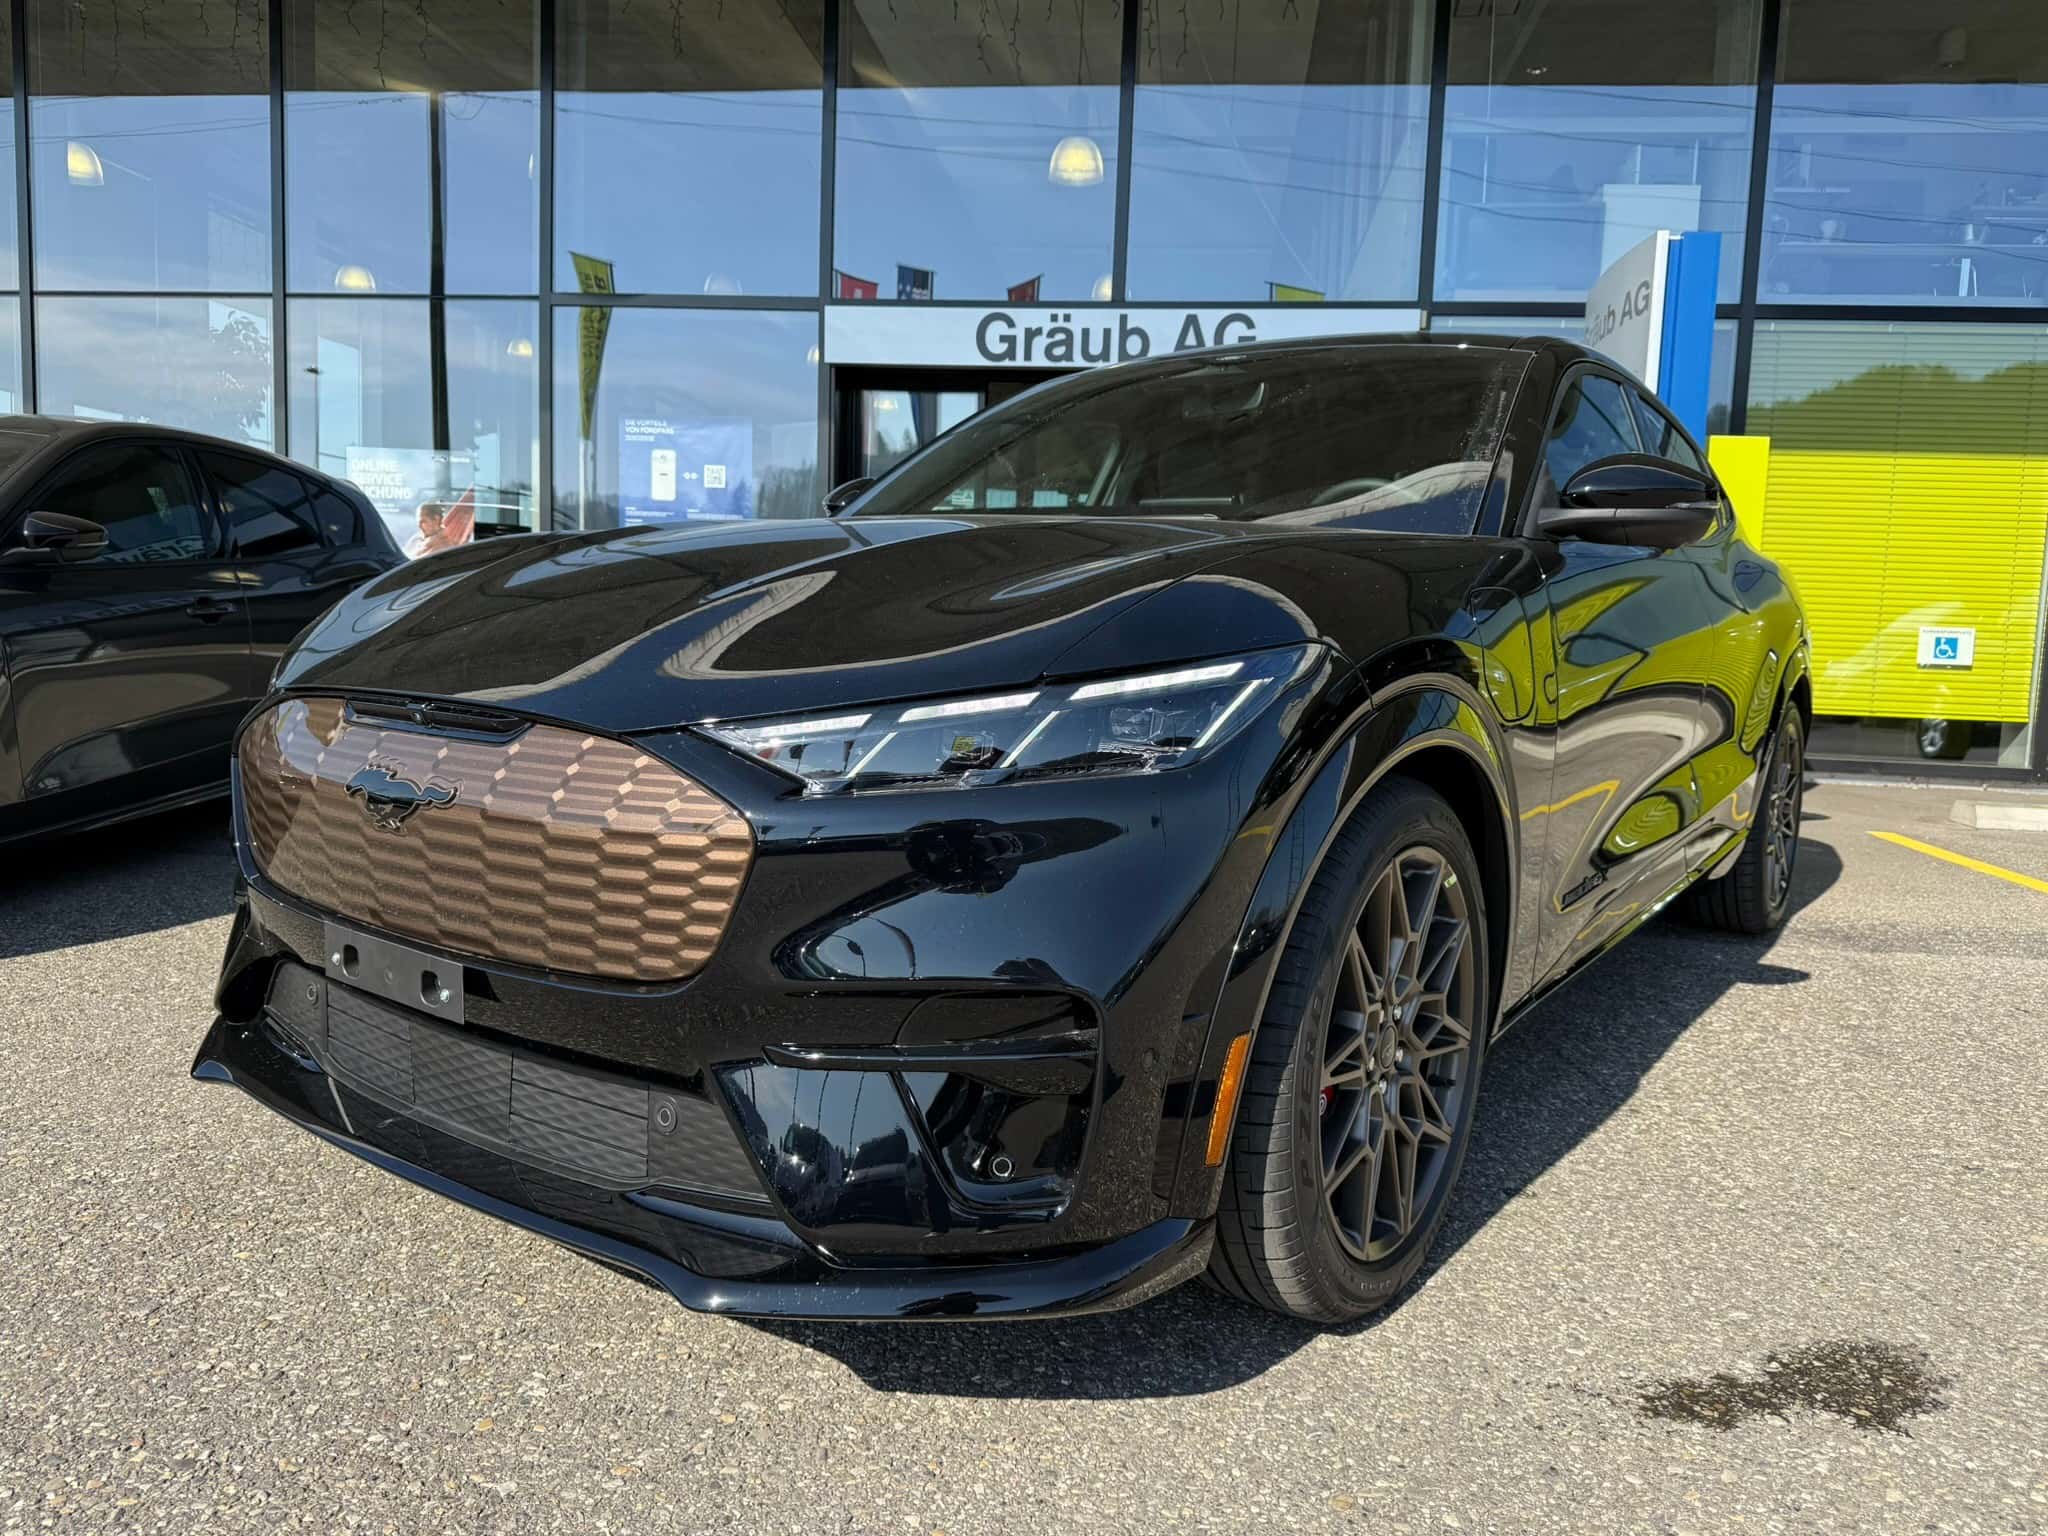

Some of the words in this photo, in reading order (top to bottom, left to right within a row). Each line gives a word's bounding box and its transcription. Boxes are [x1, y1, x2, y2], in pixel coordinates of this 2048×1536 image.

[1620, 280, 1649, 327] AG
[976, 311, 1151, 363] Gräub
[1174, 312, 1257, 352] AG
